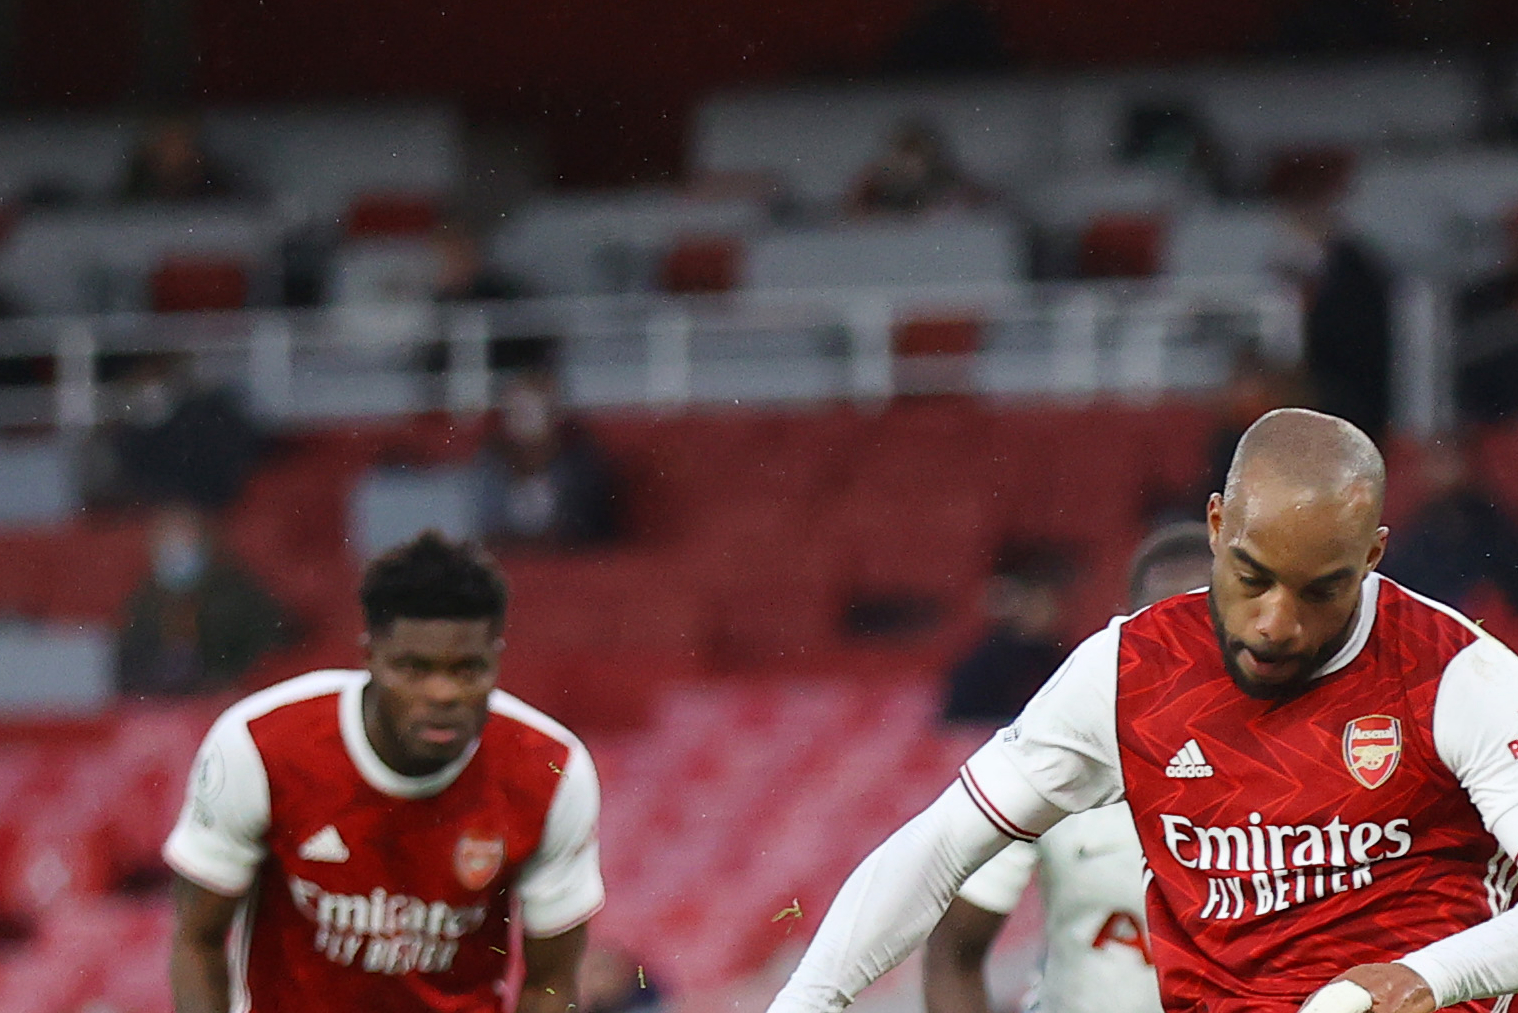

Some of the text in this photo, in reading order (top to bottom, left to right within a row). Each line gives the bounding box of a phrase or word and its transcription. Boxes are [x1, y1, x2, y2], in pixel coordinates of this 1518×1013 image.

[1165, 763, 1214, 778] adidas
[1159, 811, 1412, 872] Emirates
[1200, 865, 1373, 920] FLY BETTER
